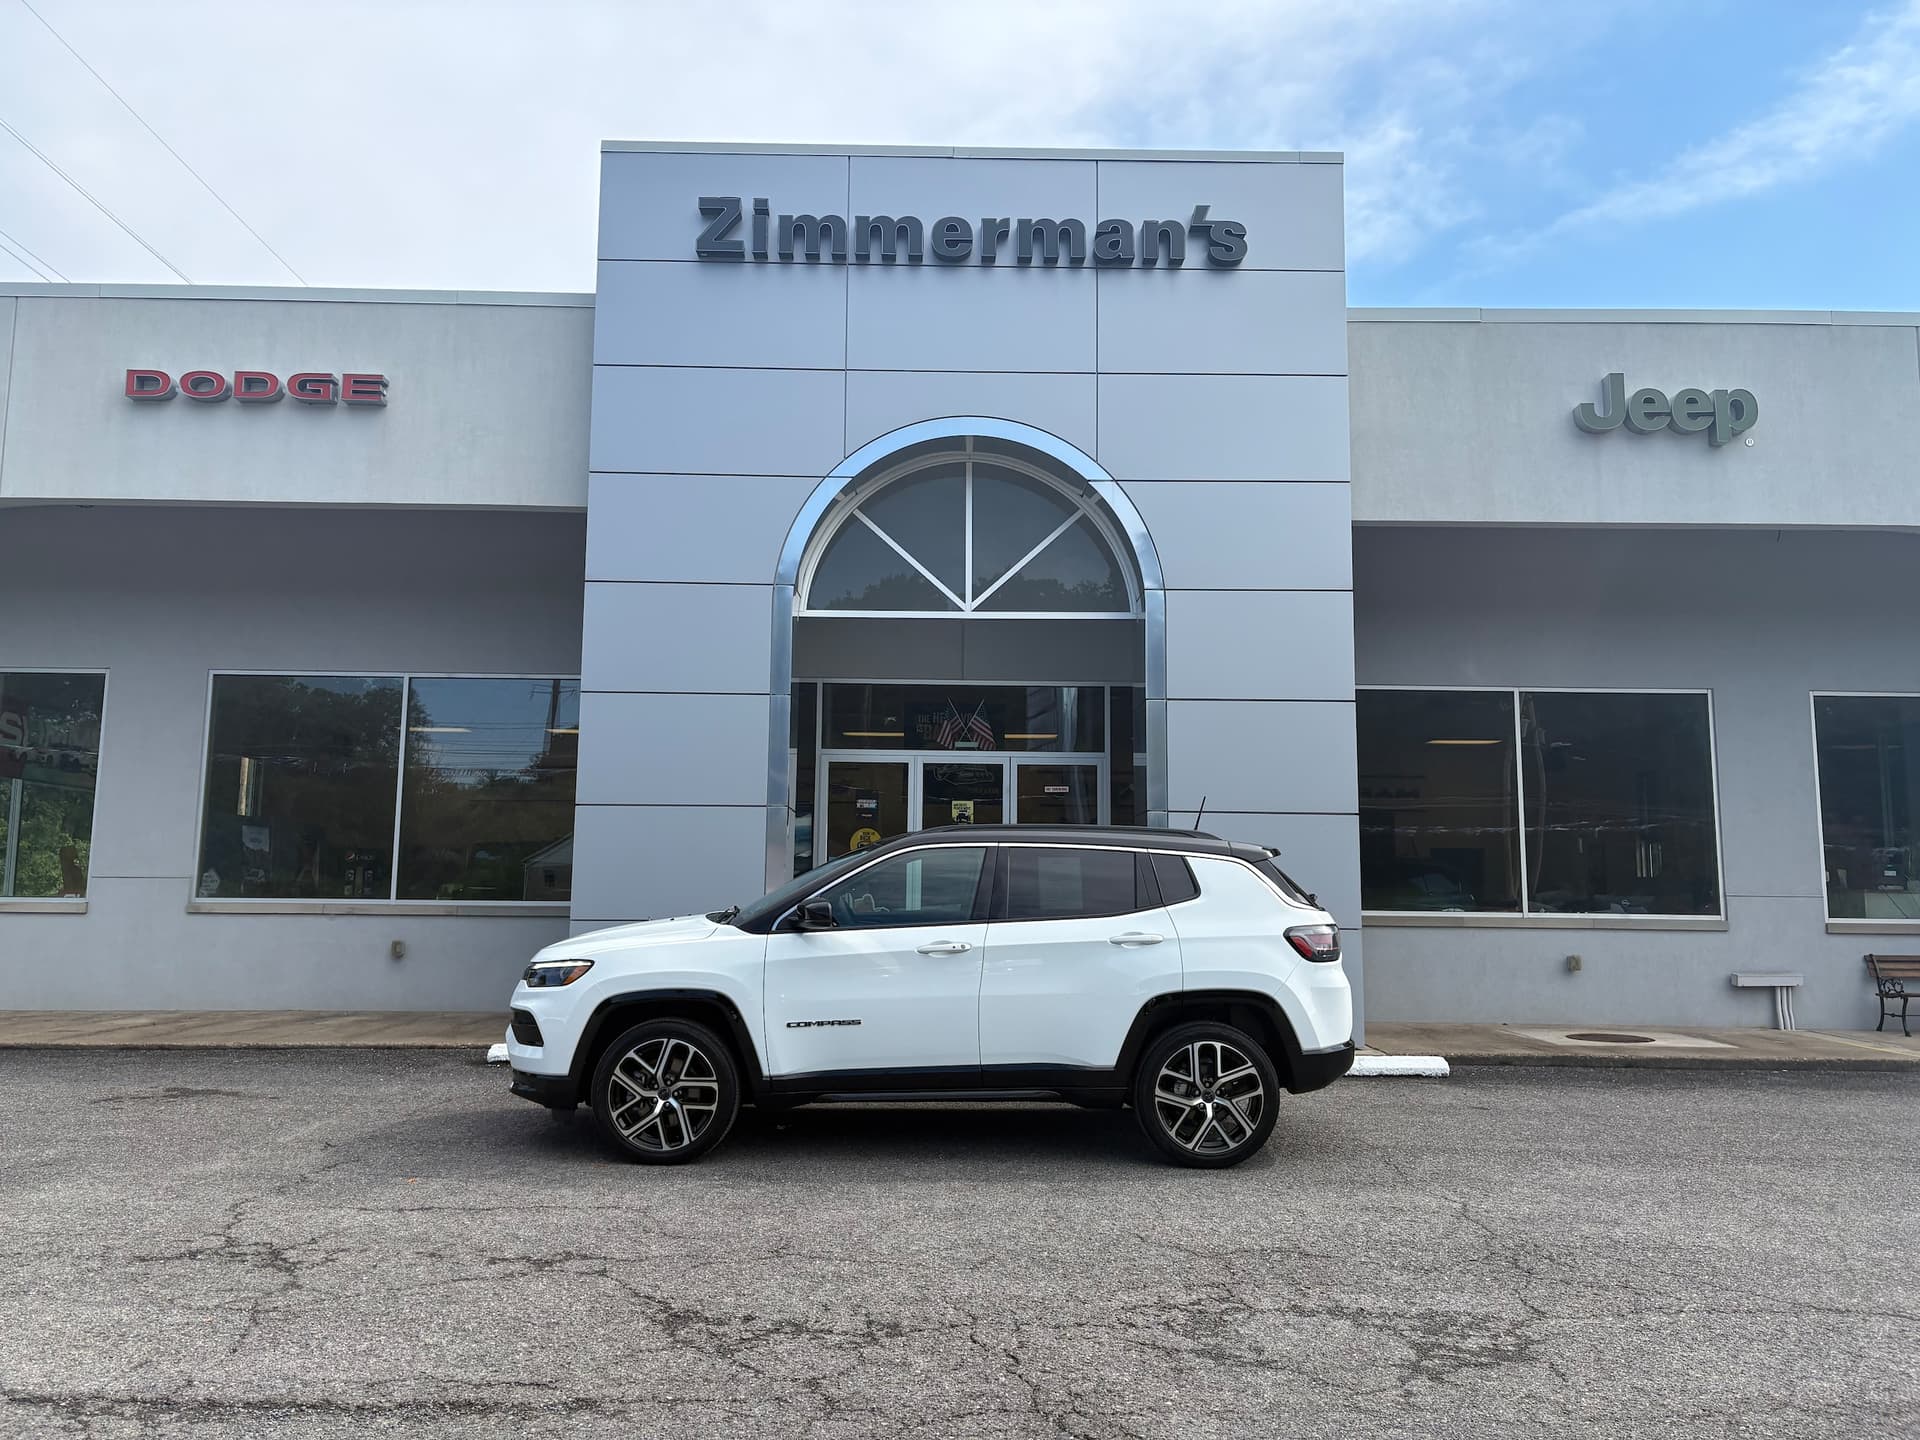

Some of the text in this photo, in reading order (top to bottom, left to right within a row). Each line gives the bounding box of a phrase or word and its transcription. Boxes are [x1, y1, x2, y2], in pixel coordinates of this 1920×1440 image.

[696, 197, 1248, 266] Zimmerman's
[125, 369, 388, 407] DODGE
[1573, 373, 1758, 447] Jeep
[786, 1019, 861, 1029] COMPASS
